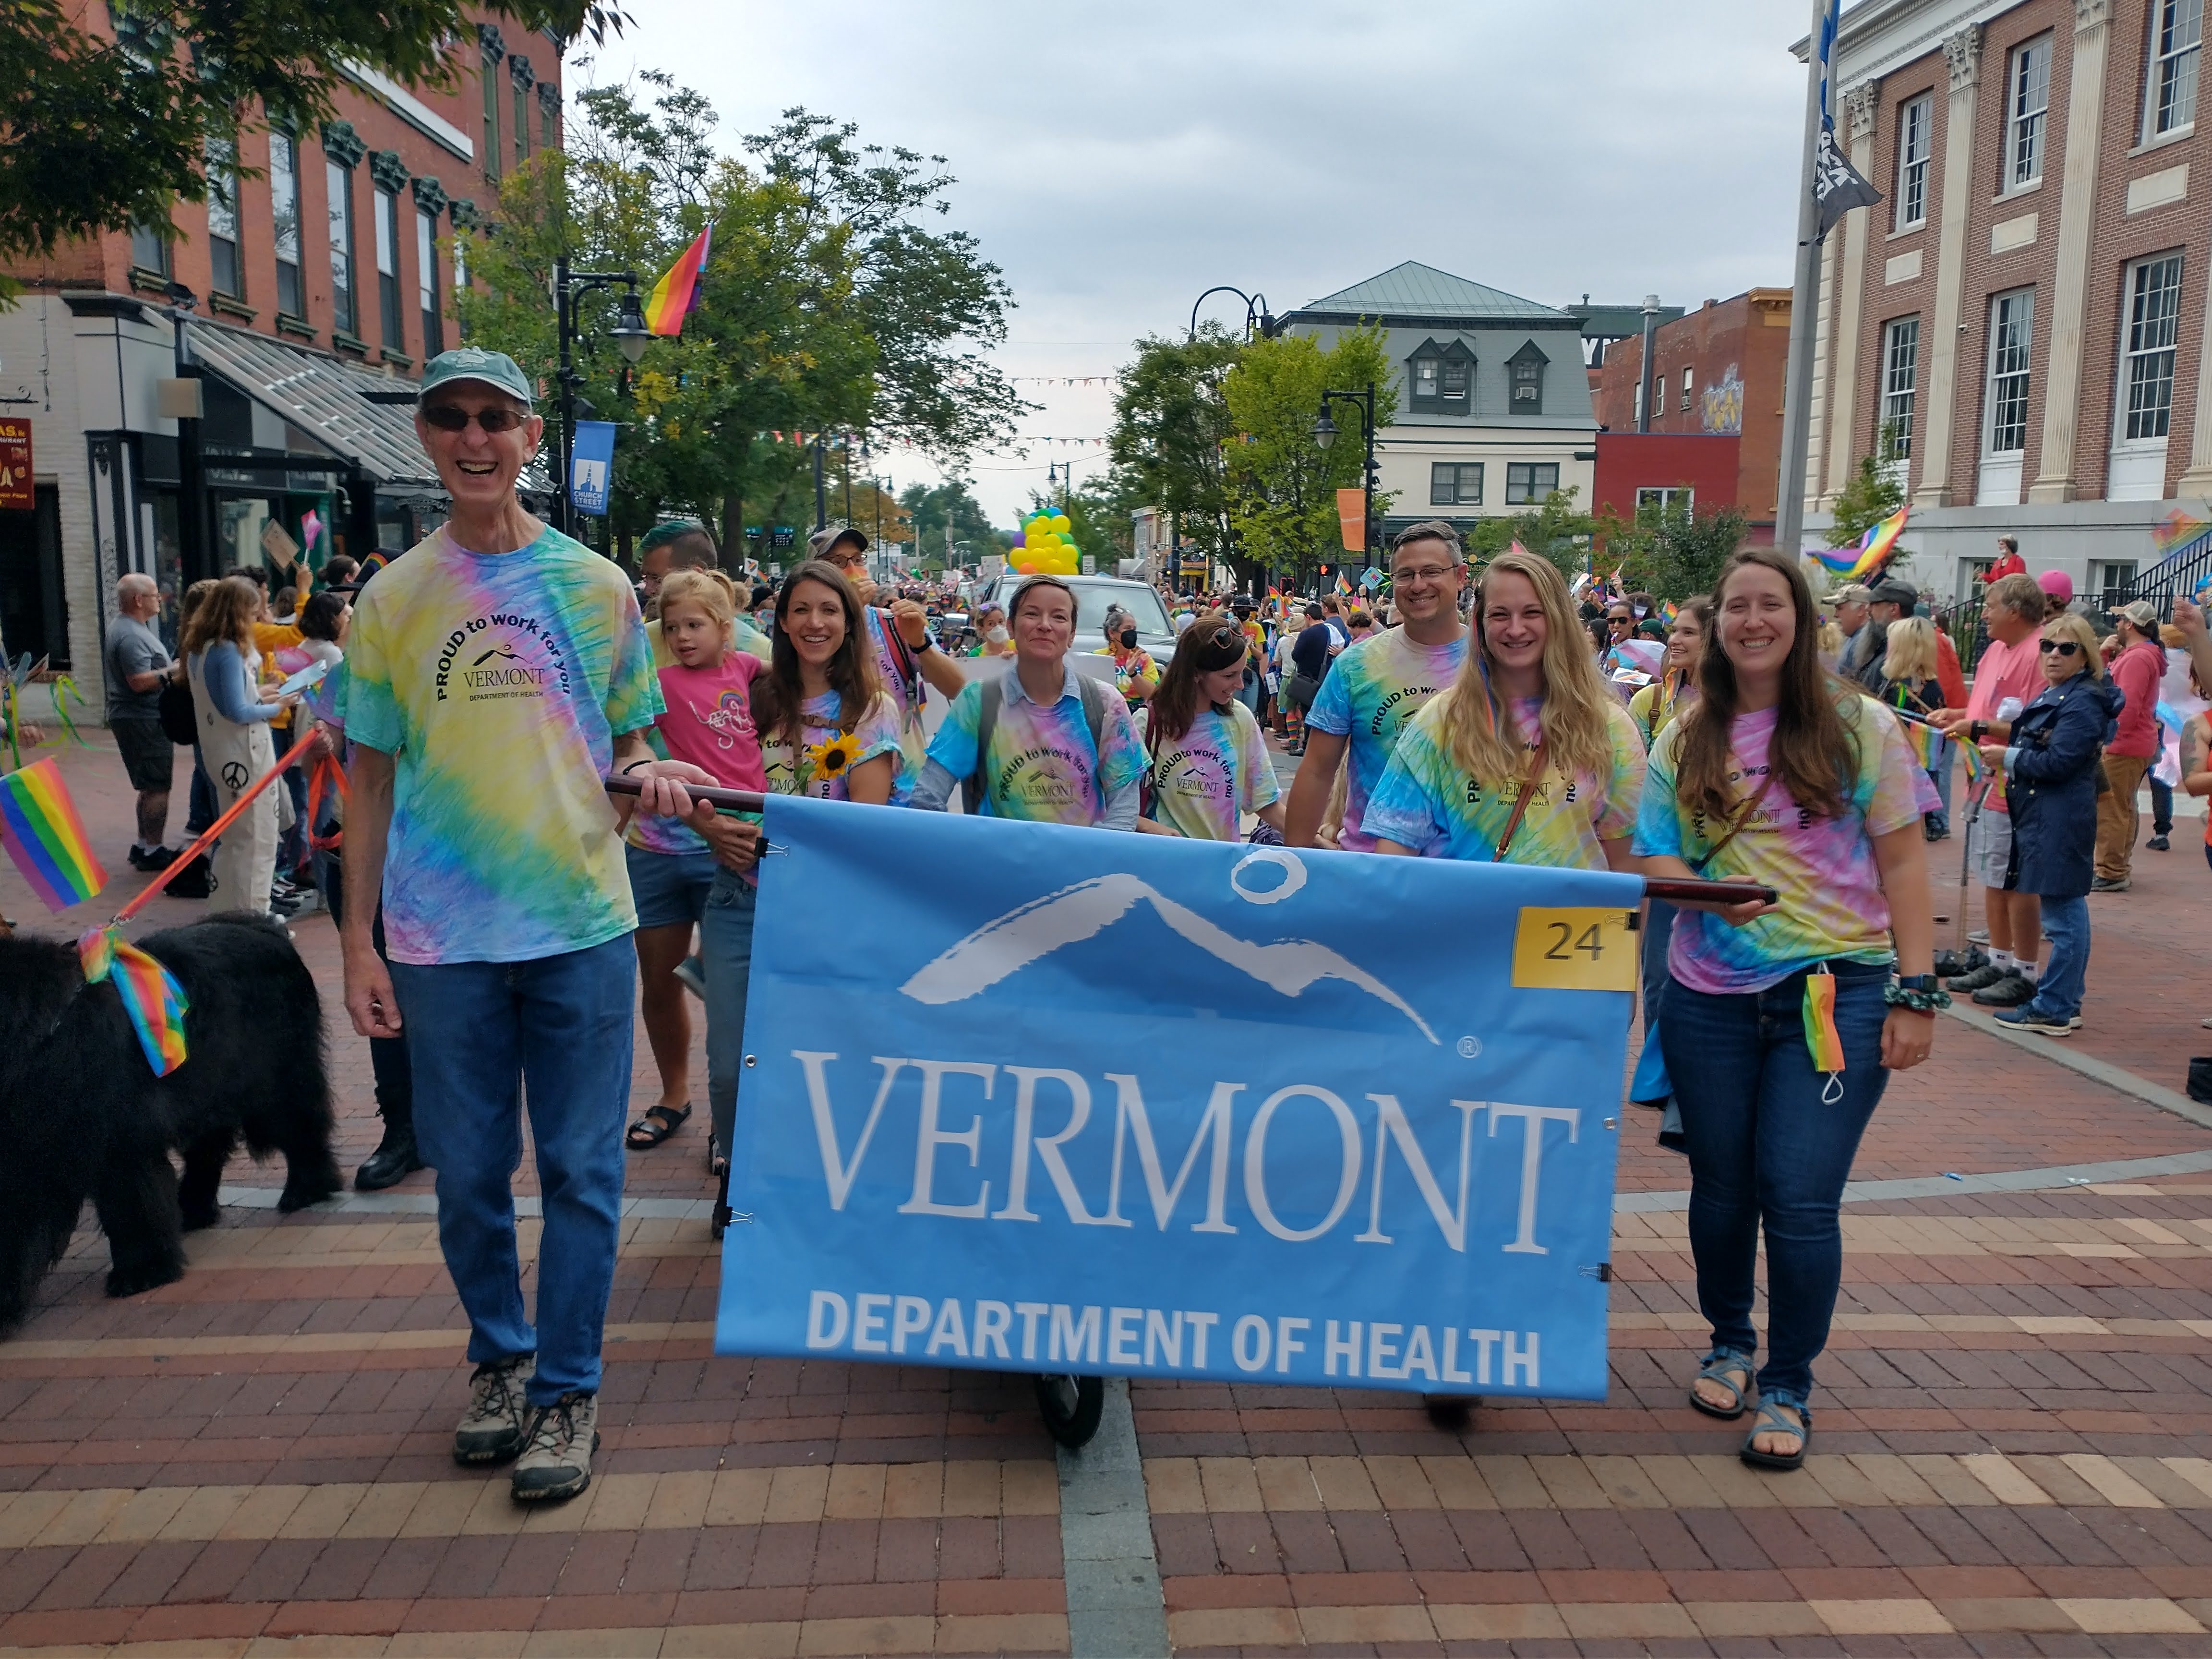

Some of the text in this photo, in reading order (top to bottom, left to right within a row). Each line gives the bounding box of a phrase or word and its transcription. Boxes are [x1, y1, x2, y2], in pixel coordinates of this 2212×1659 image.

[574, 491, 602, 499] CHURCH
[574, 497, 602, 505] STREET
[436, 614, 571, 702] PROUD to work for you
[463, 668, 545, 688] VERMONT
[469, 692, 510, 701] DEPARTMENT
[1371, 692, 1401, 735] PROUD
[1403, 687, 1417, 697] to
[1420, 686, 1438, 695] wo
[998, 754, 1025, 802] PROUD
[1024, 748, 1039, 761] to
[1040, 746, 1073, 763] work
[1021, 783, 1076, 797] VERMONT
[1157, 749, 1234, 798] PROUD to work for you
[1177, 778, 1220, 792] VERMONT
[1543, 922, 1606, 961] 24
[791, 1049, 1581, 1255] VERMONT
[805, 1289, 1540, 1387] DEPARTMENT OF HEALTH
